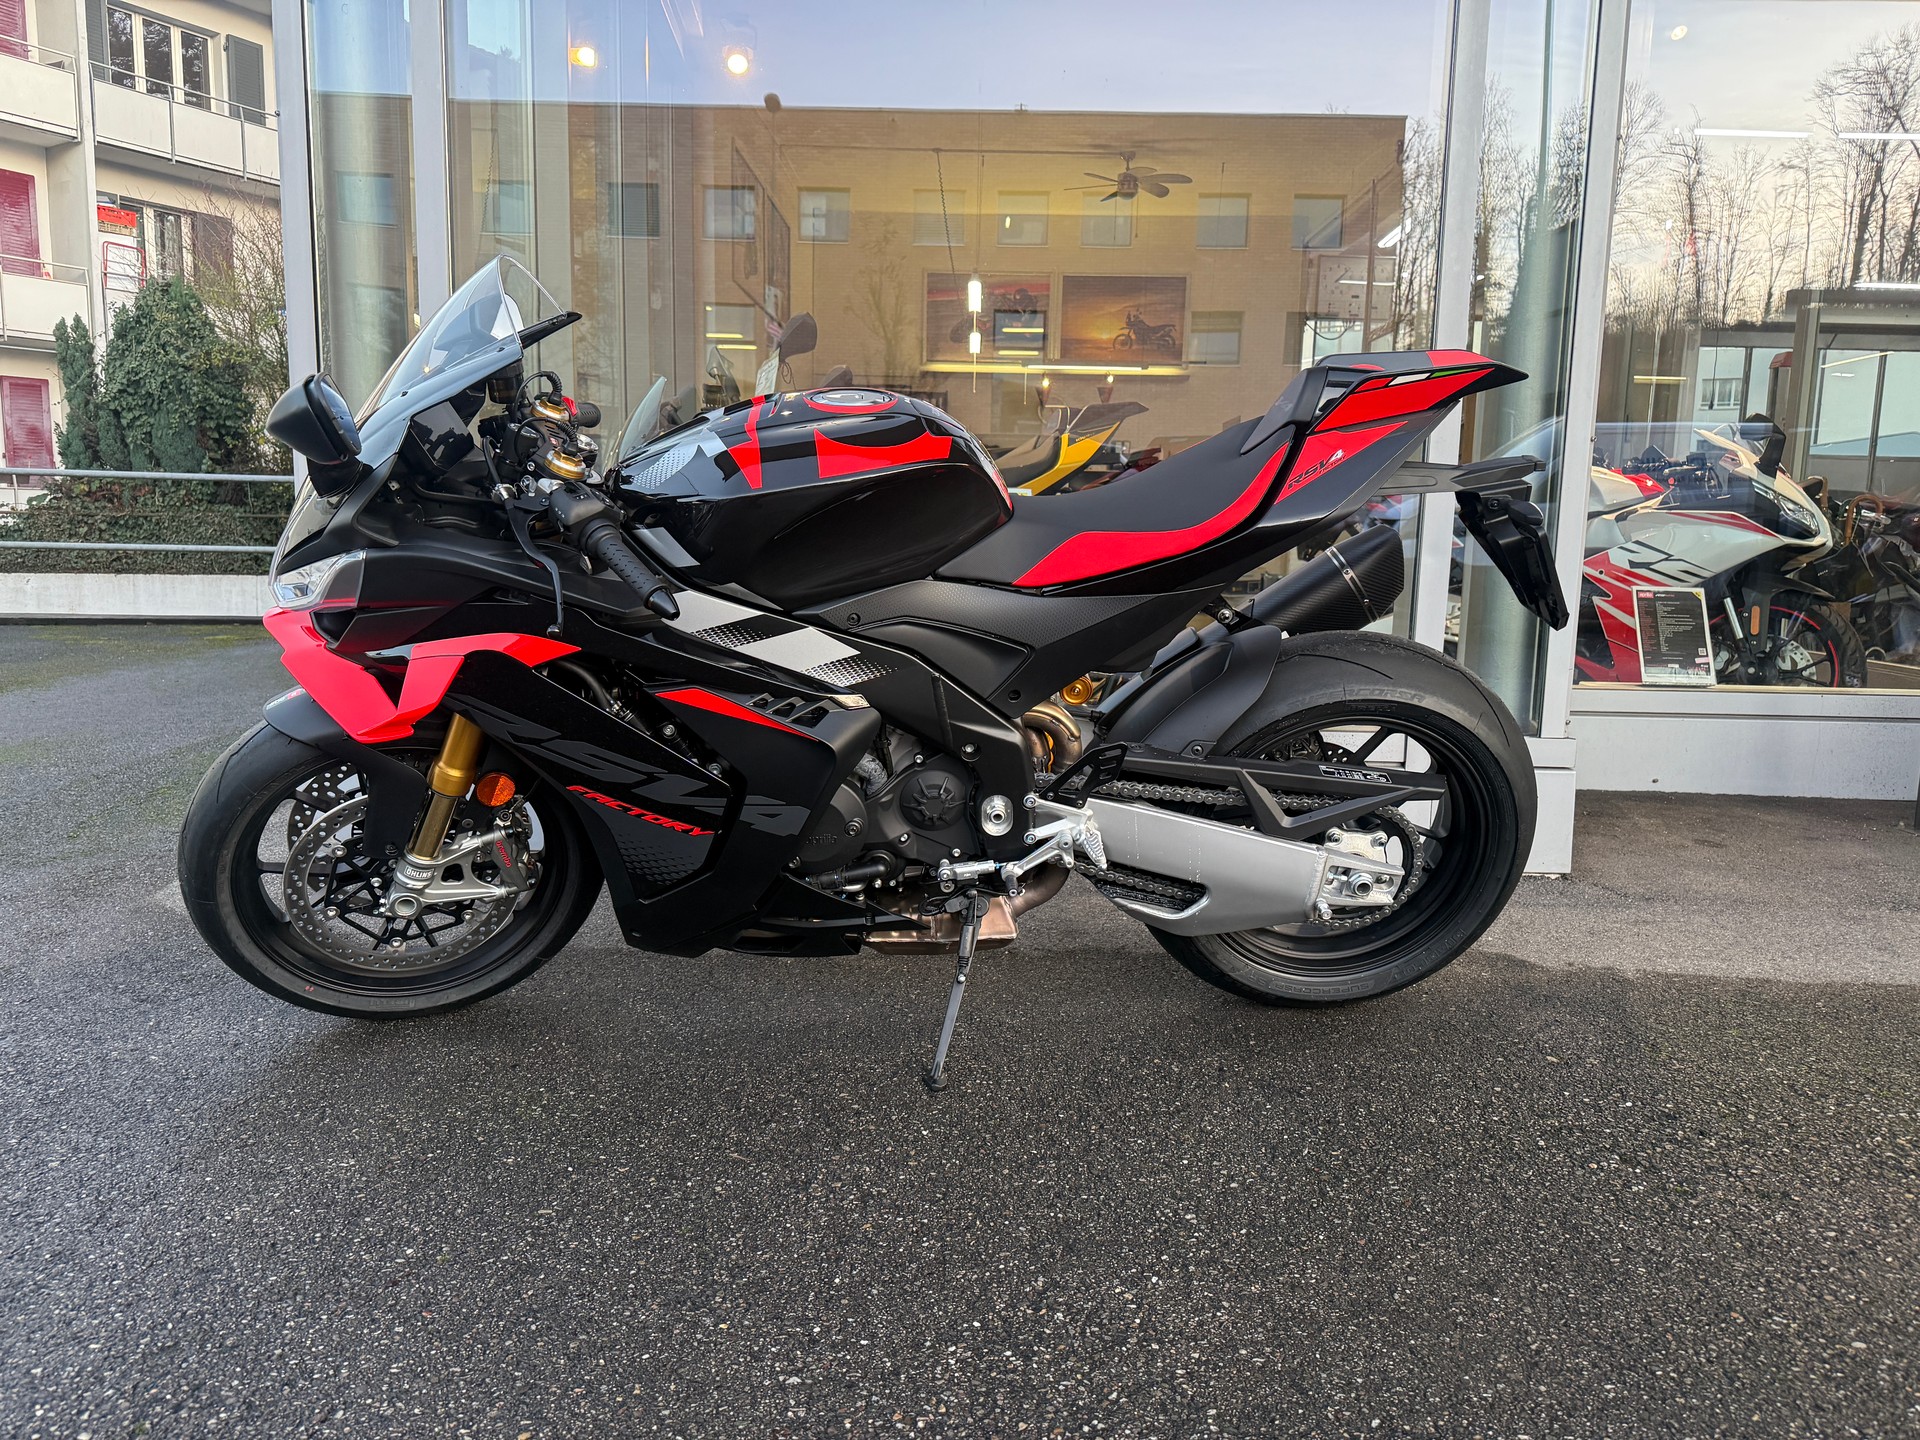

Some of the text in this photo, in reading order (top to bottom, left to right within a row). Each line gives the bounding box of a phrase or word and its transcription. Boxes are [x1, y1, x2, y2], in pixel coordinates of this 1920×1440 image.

[1288, 449, 1345, 490] RSV4
[565, 784, 716, 837] FACTORY
[496, 840, 512, 868] brembo
